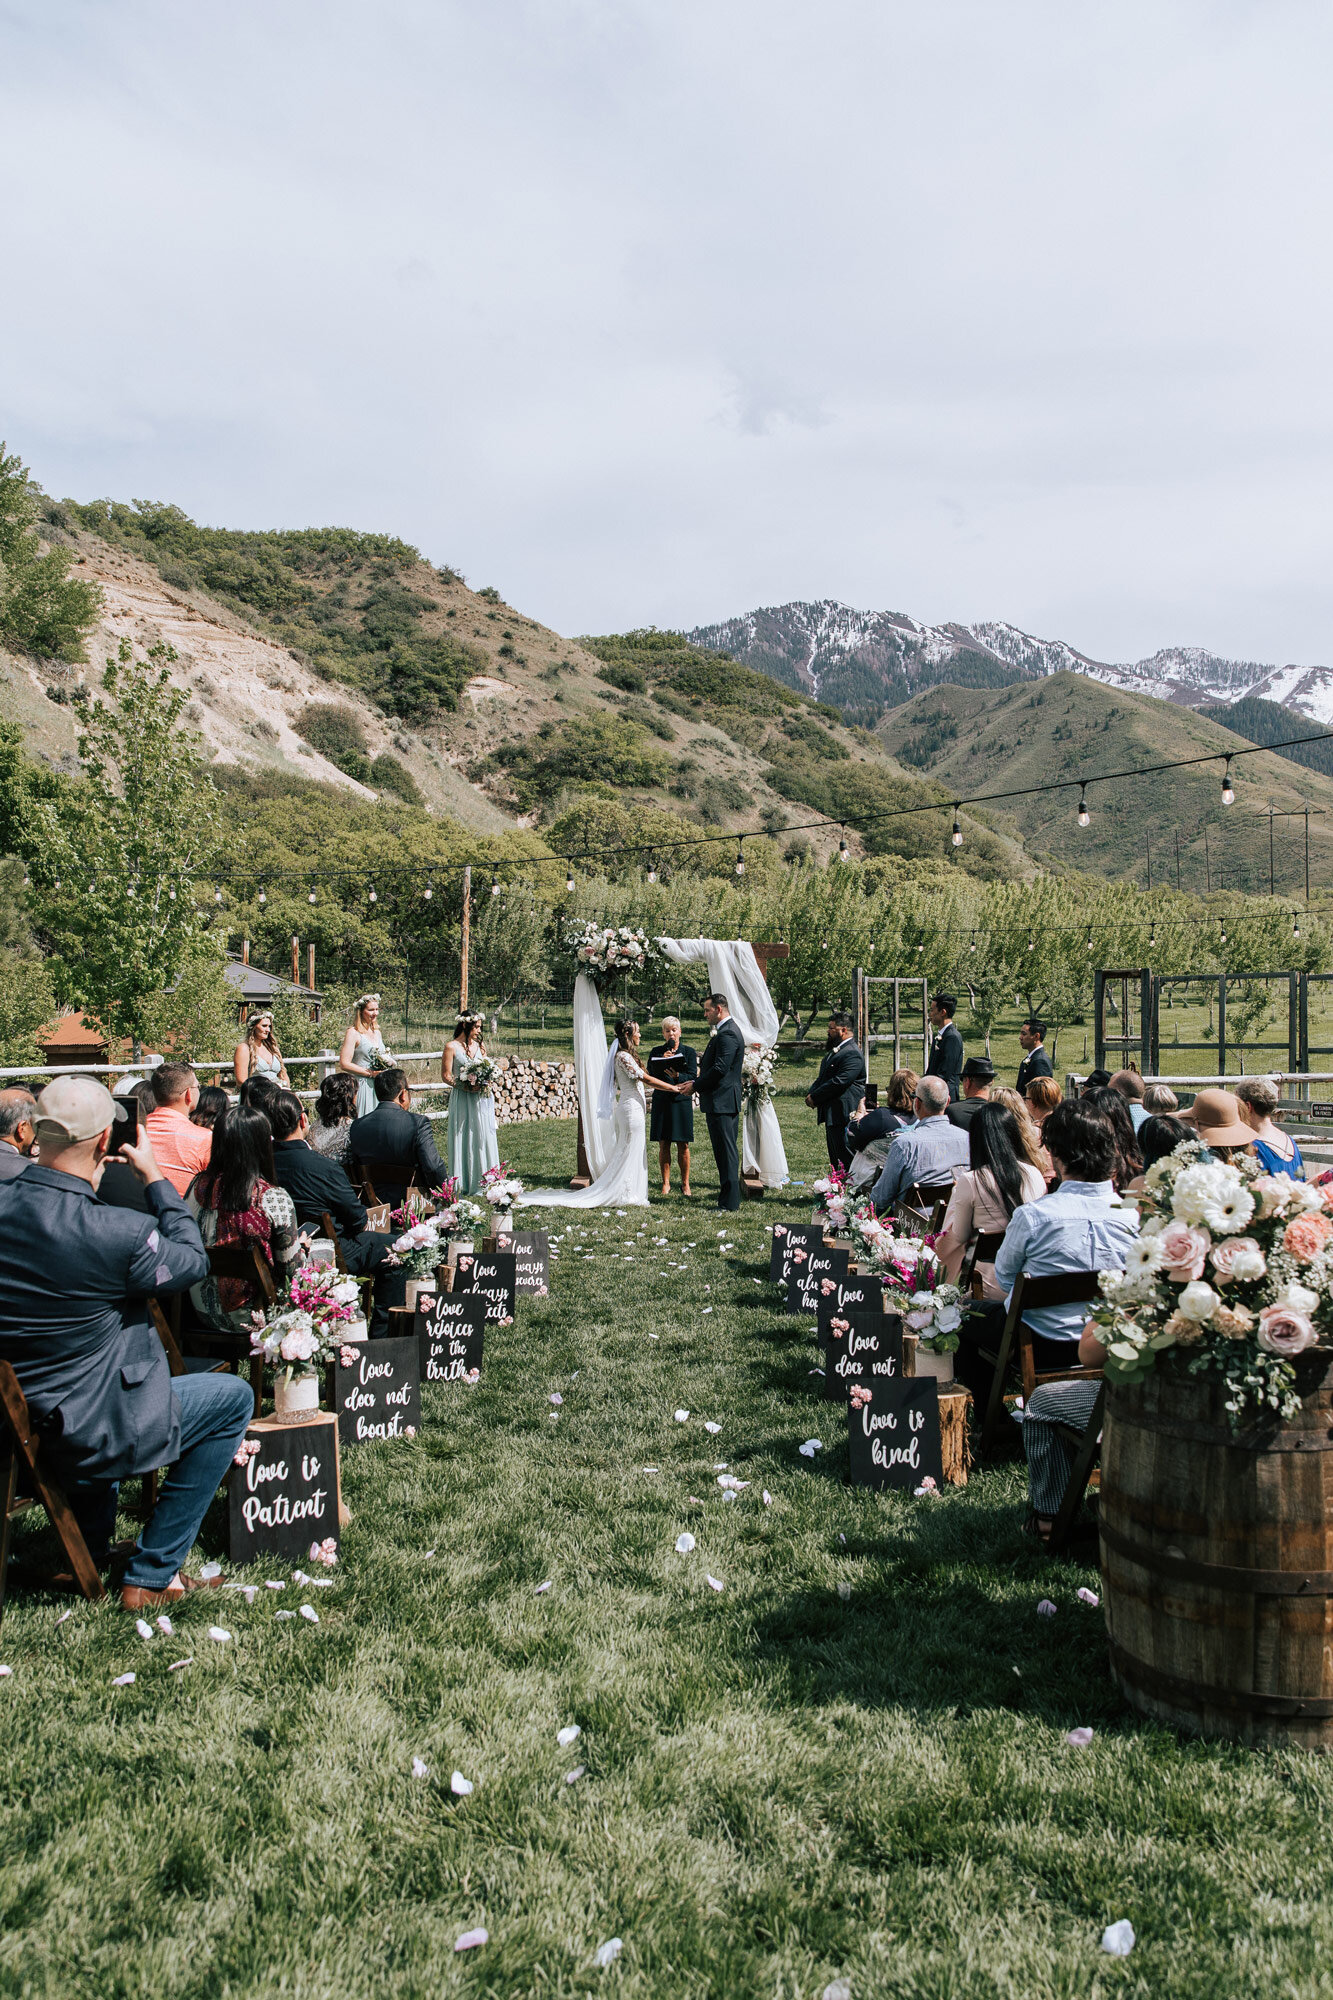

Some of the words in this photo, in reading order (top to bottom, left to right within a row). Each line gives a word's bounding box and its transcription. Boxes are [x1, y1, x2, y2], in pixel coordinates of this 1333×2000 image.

[426, 1319, 473, 1339] rejoices
[431, 1344, 443, 1356] in
[449, 1340, 466, 1355] the
[427, 1358, 468, 1381] truth
[835, 1354, 863, 1377] does
[873, 1356, 896, 1376] not
[345, 1384, 375, 1410] does
[386, 1382, 412, 1405] not
[357, 1411, 403, 1441] boast
[909, 1410, 924, 1431] is
[872, 1437, 919, 1468] kind
[302, 1455, 321, 1481] is
